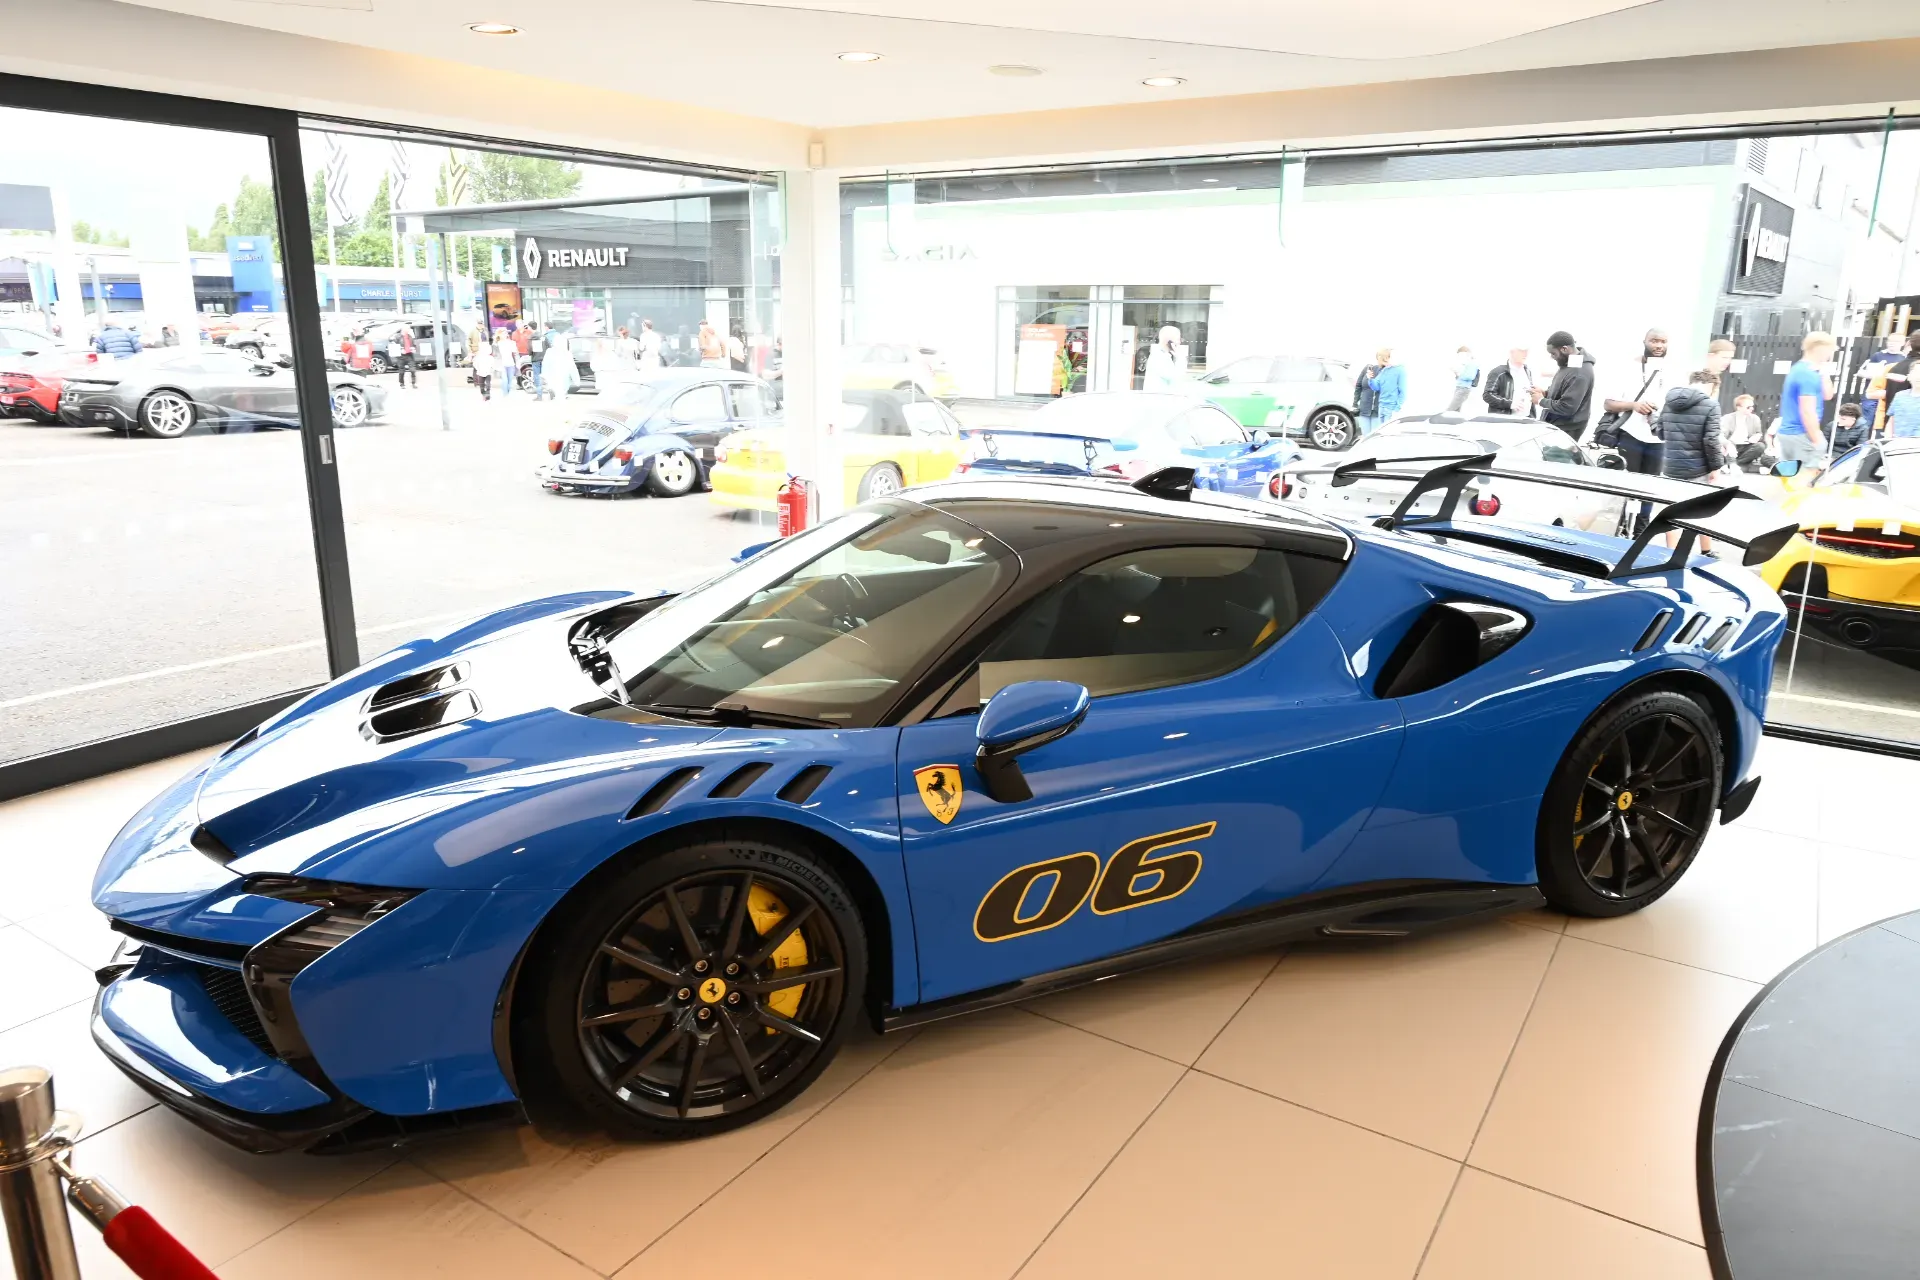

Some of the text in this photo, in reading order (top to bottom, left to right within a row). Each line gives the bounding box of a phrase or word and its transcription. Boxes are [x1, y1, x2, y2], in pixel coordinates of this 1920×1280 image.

[547, 247, 629, 268] RENAULT
[1324, 494, 1420, 508] LOTUS
[973, 821, 1217, 942] 06
